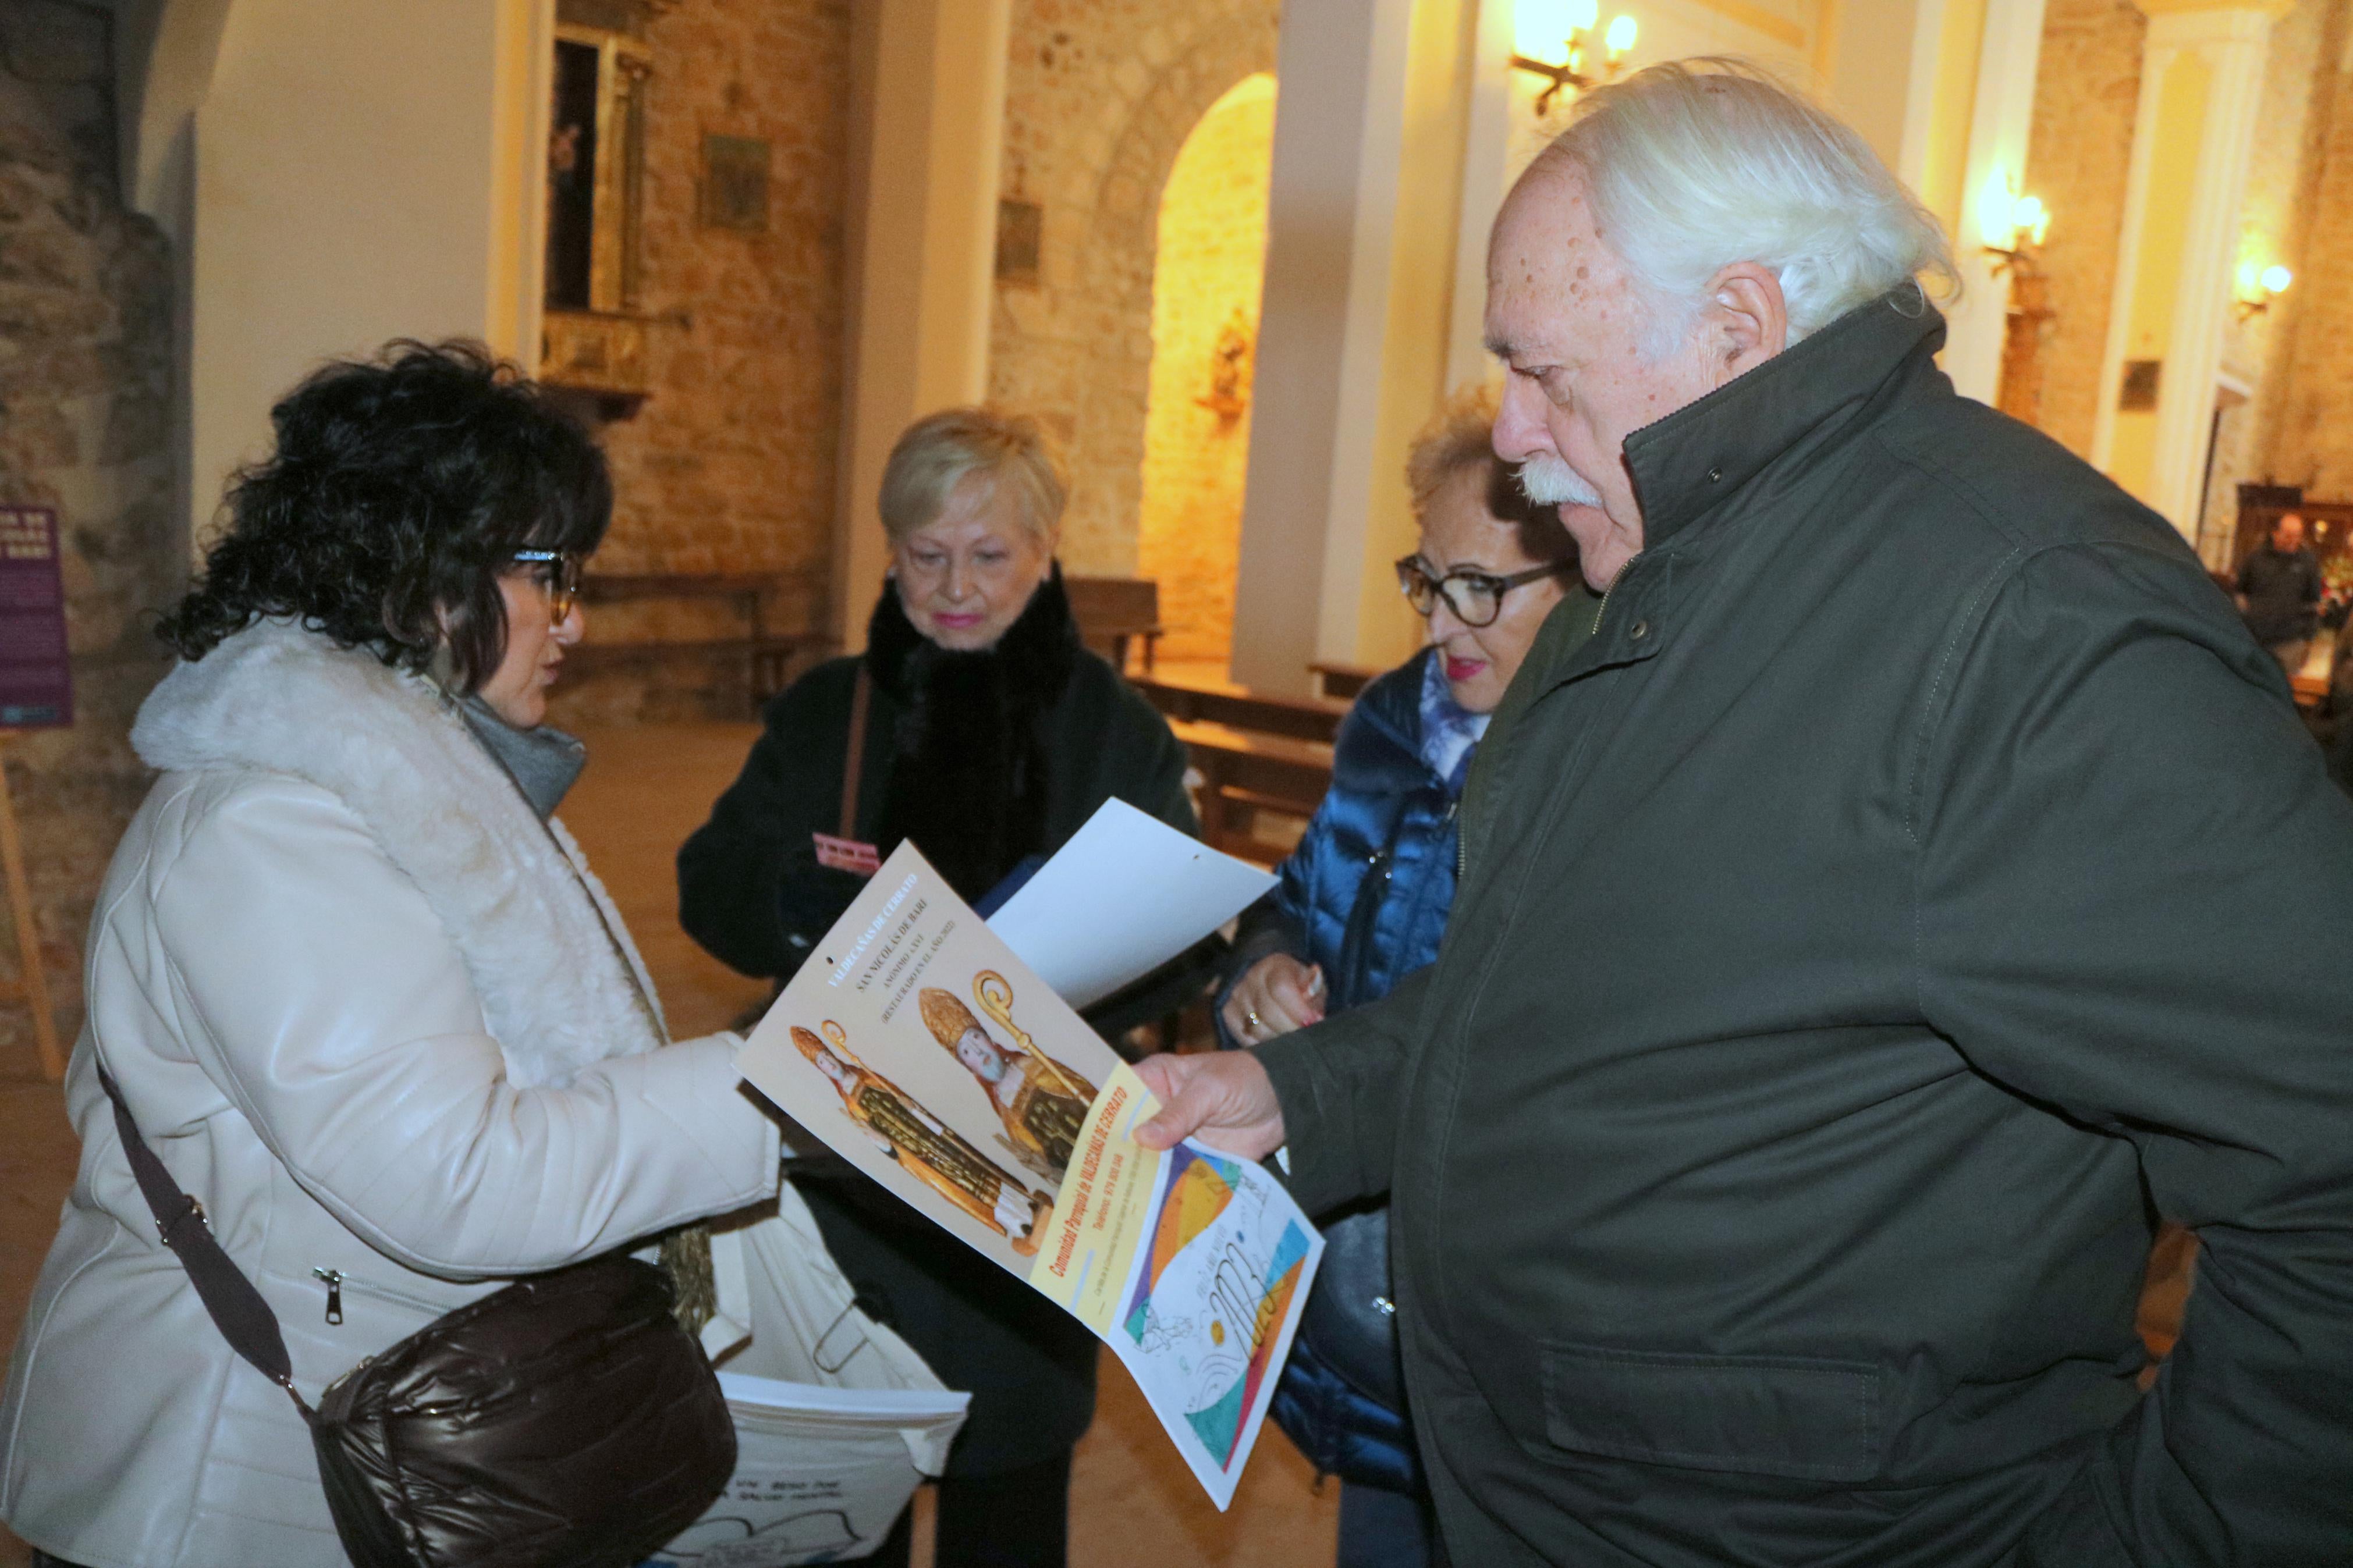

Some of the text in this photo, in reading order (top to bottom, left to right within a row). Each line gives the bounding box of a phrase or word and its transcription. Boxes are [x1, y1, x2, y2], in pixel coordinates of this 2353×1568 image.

[826, 872, 918, 987] VALDECAÑAS DE CERRATO
[856, 898, 927, 993] SAN NICOLÁS DE BARI
[883, 952, 910, 989] ANÓNIMO
[880, 972, 917, 1025] (RESTAURADO
[914, 964, 924, 974] EN
[922, 952, 932, 963] EL
[930, 934, 942, 952] AÑO
[1048, 1086, 1127, 1278] Comunidad Parroquial de VALDECAÑAS DE CERRATO
